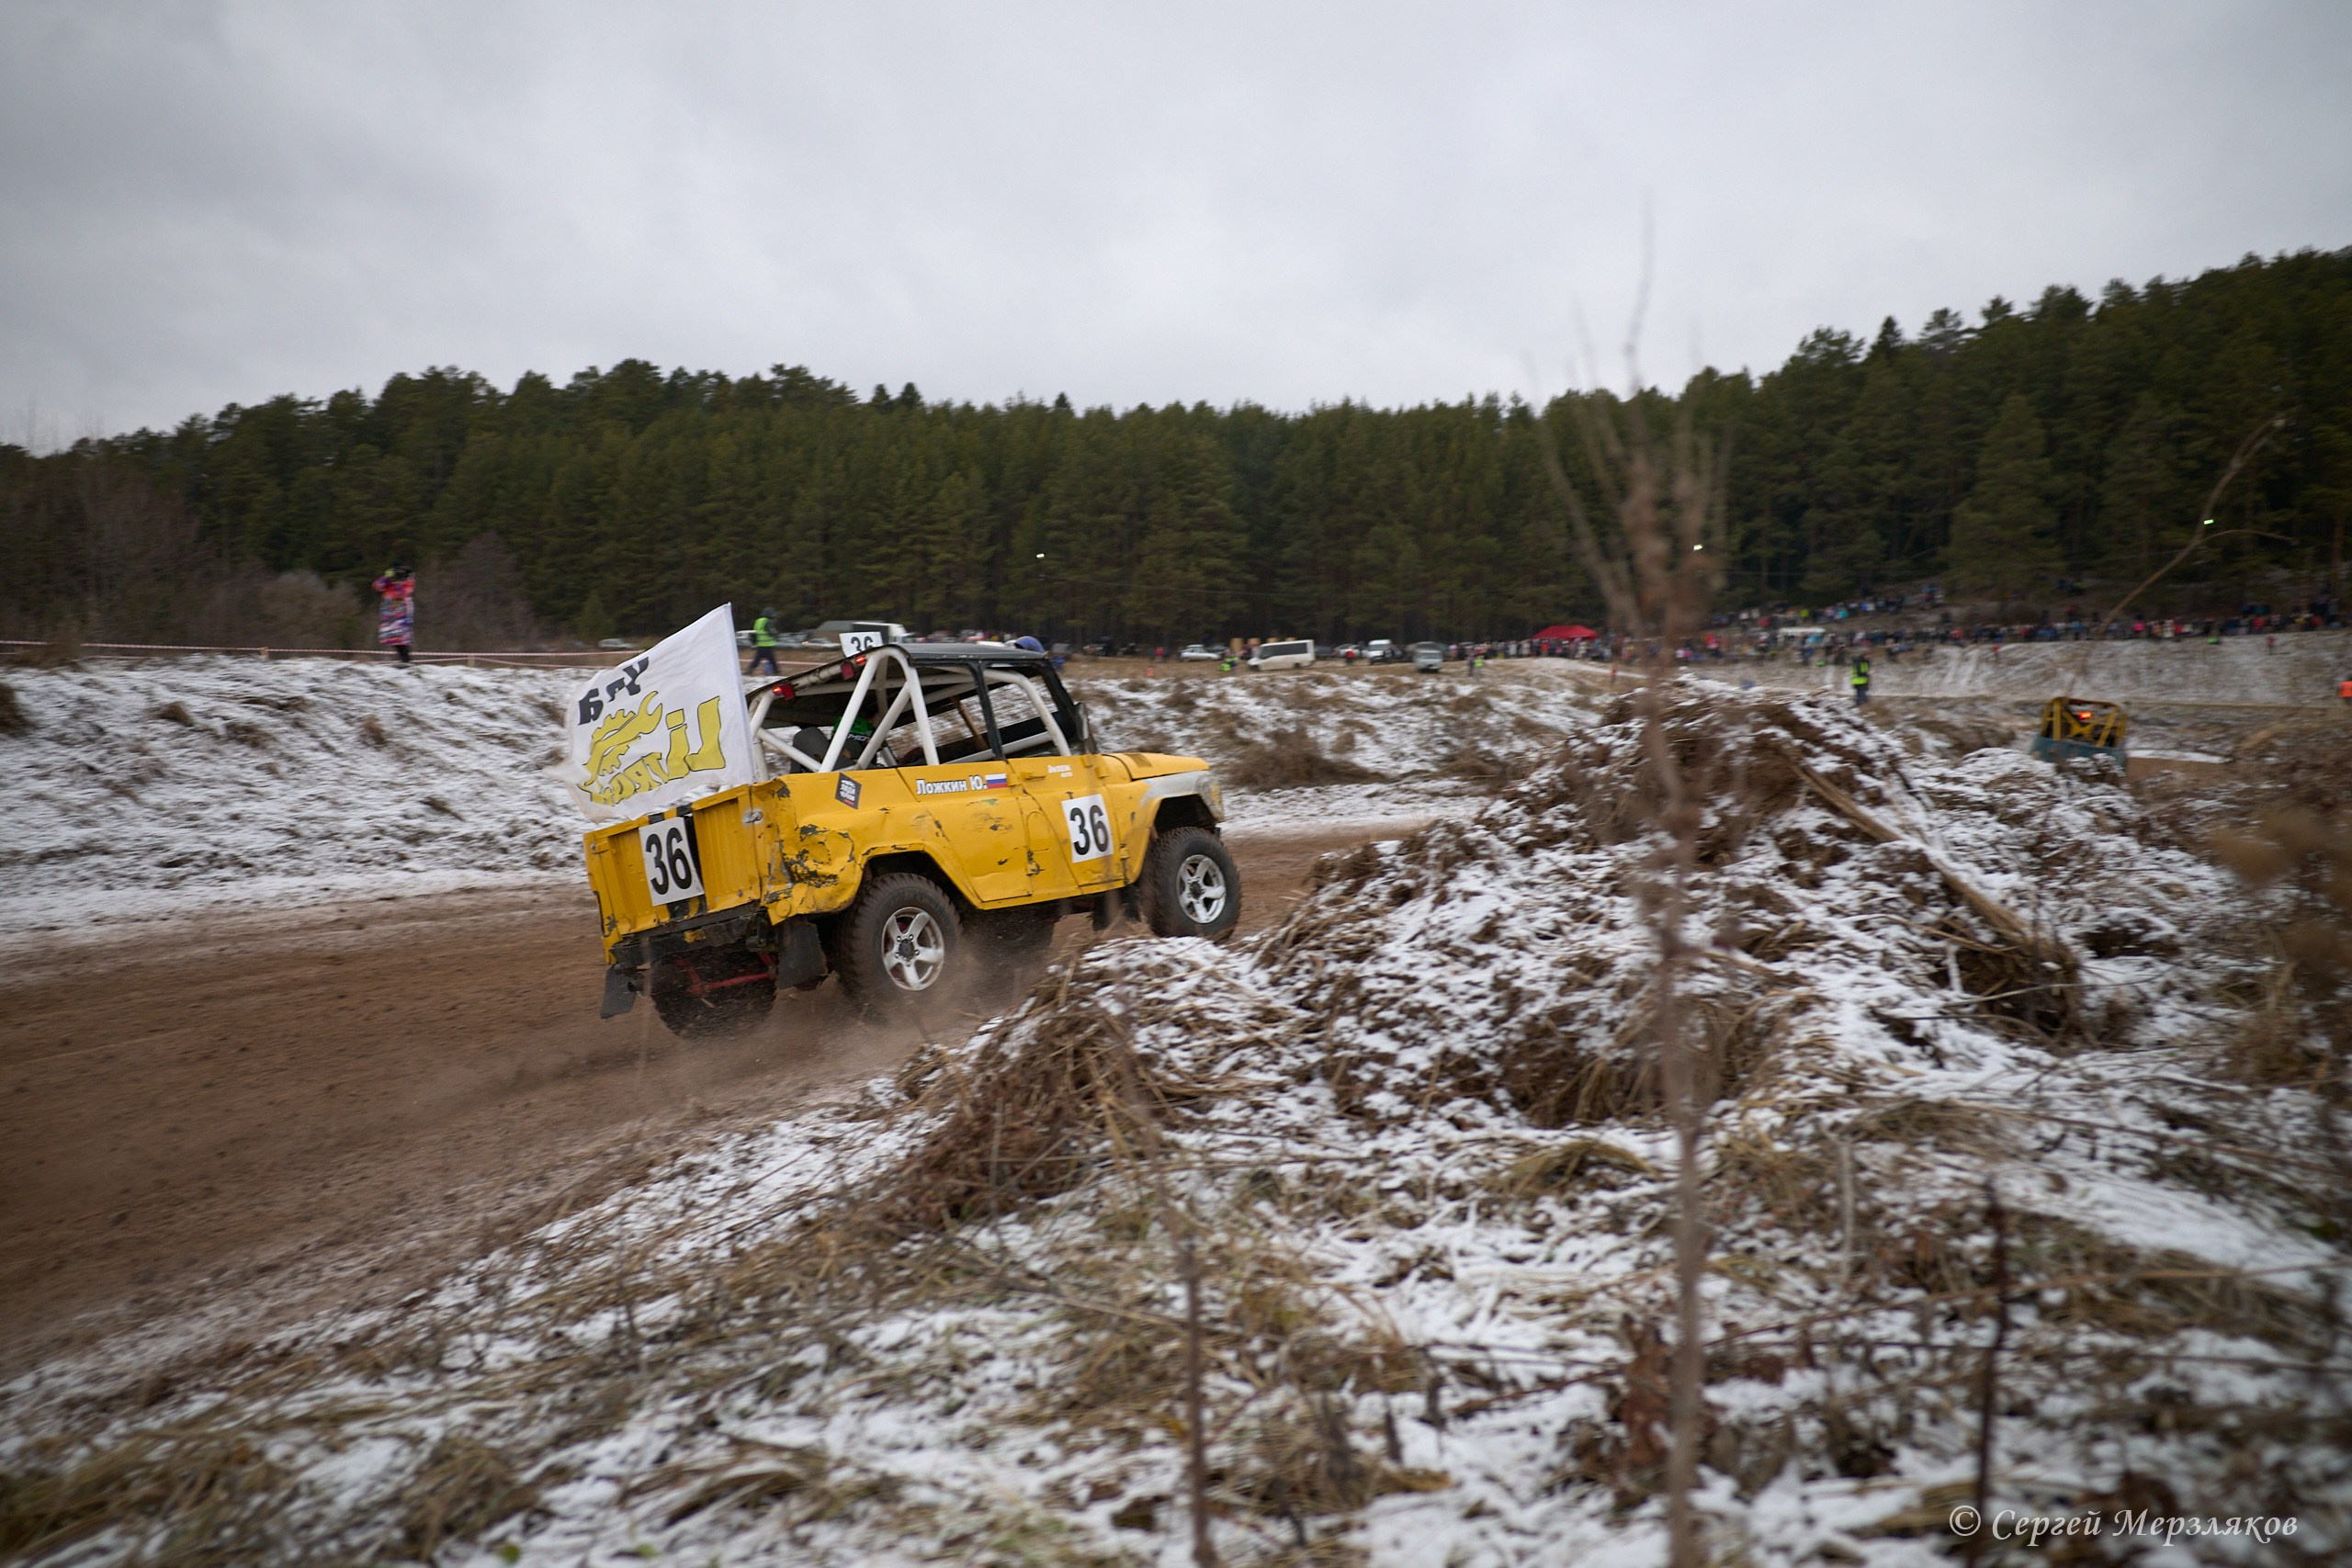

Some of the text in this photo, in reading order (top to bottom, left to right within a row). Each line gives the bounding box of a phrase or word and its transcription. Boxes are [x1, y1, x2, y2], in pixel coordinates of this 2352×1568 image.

[851, 636, 874, 652] 36
[916, 774, 988, 795] Ложкин Ю.
[1070, 805, 1108, 855] 36
[646, 827, 692, 895] 36
